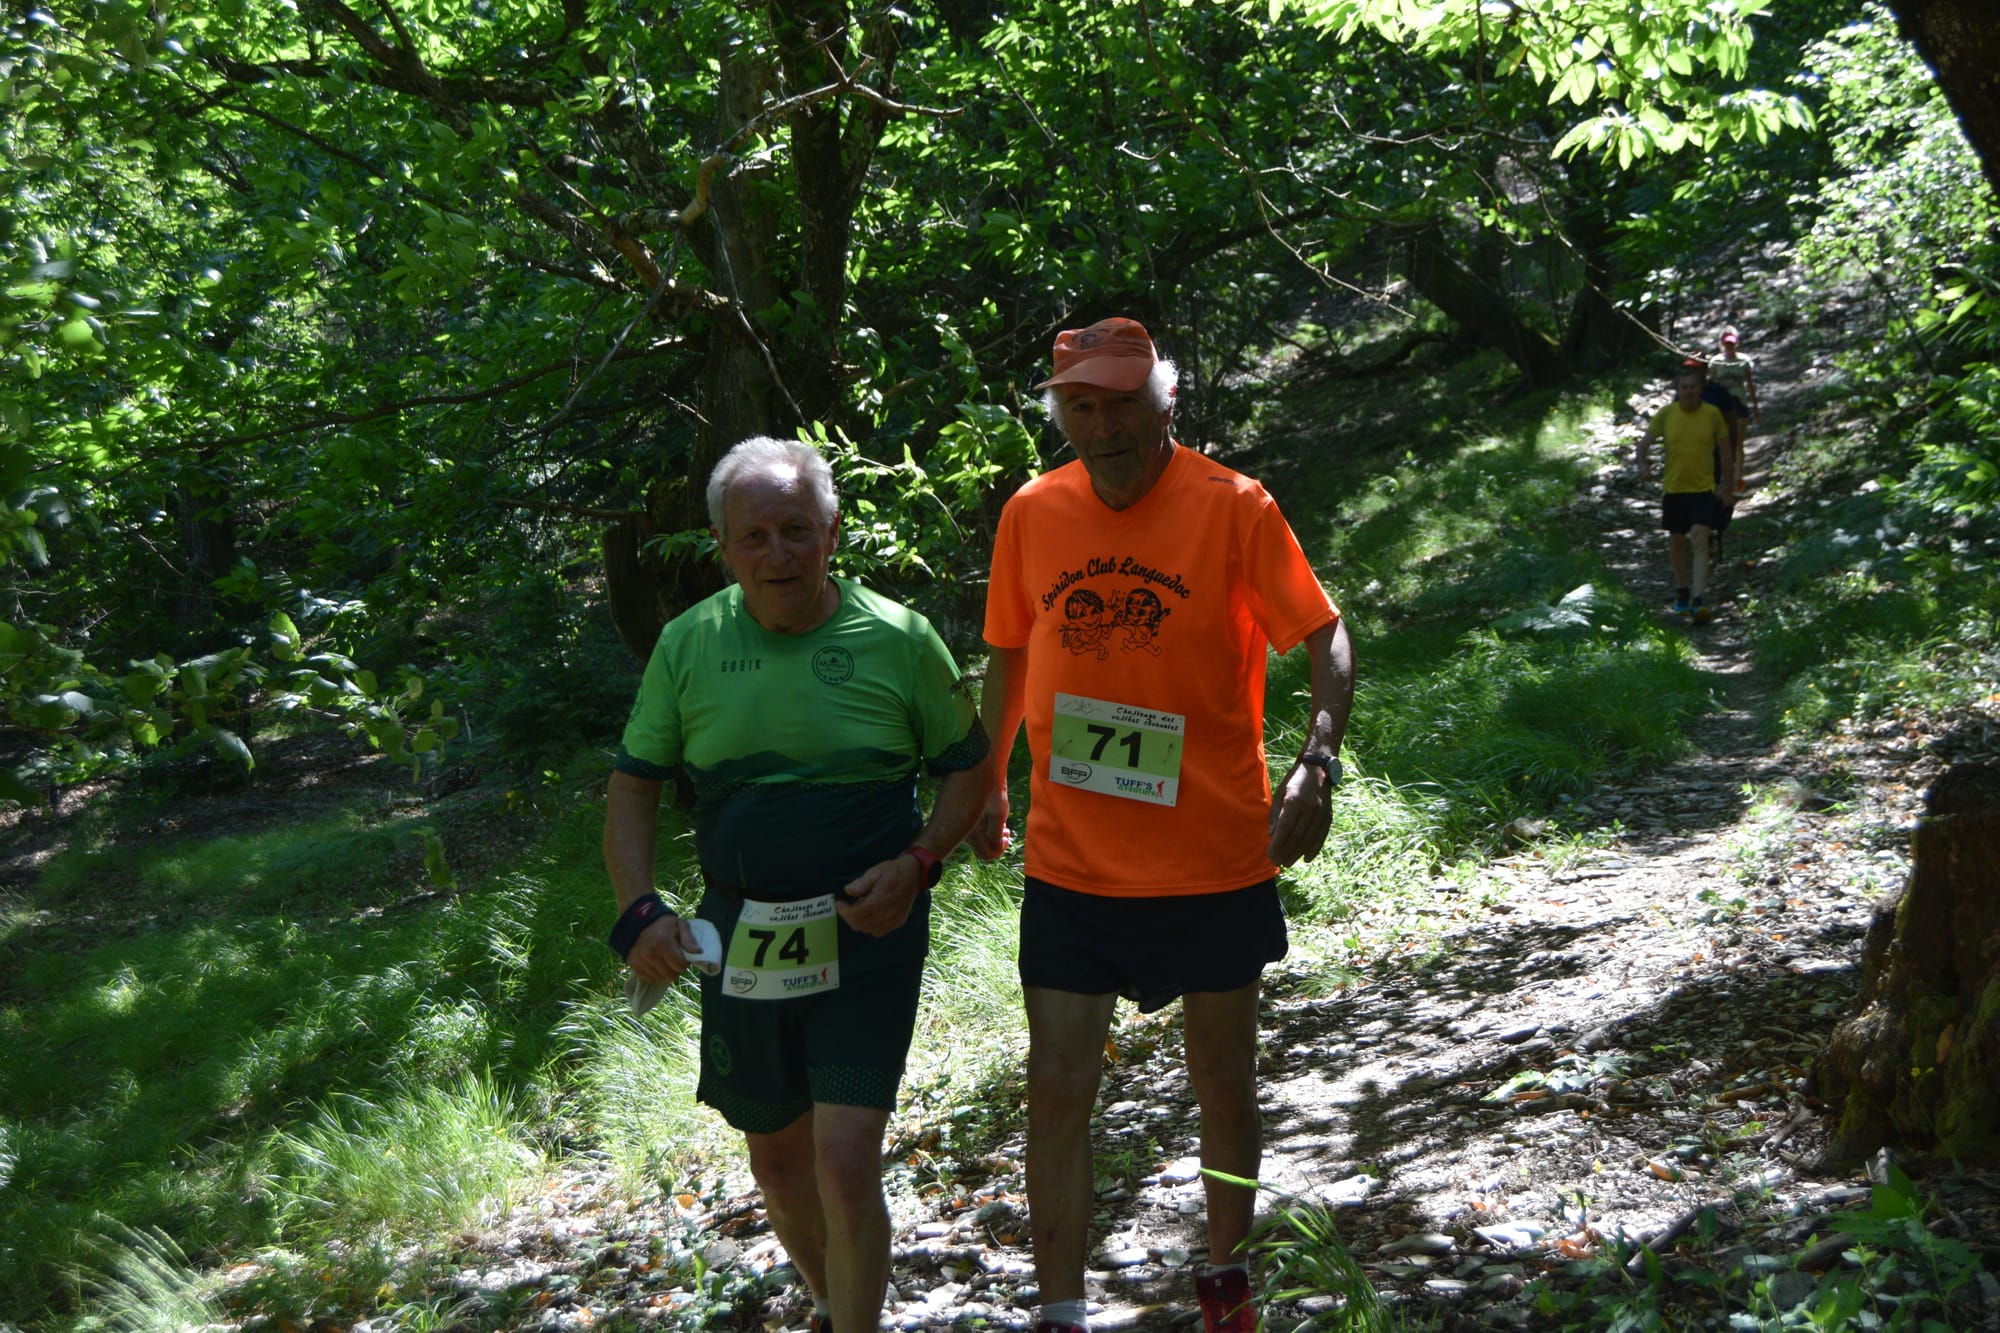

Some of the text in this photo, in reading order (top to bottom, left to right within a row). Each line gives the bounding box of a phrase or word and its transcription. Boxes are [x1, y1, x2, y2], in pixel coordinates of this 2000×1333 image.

[1041, 556, 1191, 612] Spiridon Club Languedoc
[721, 658, 761, 673] GOBIK
[1116, 707, 1175, 723] Challenge des
[1087, 723, 1142, 768] 71
[1061, 766, 1088, 779] BFP
[1115, 777, 1153, 791] TUFF'S
[774, 903, 813, 914] Challenge
[748, 926, 809, 968] 74
[730, 976, 753, 987] BFP
[782, 974, 819, 987] TUFF'S
